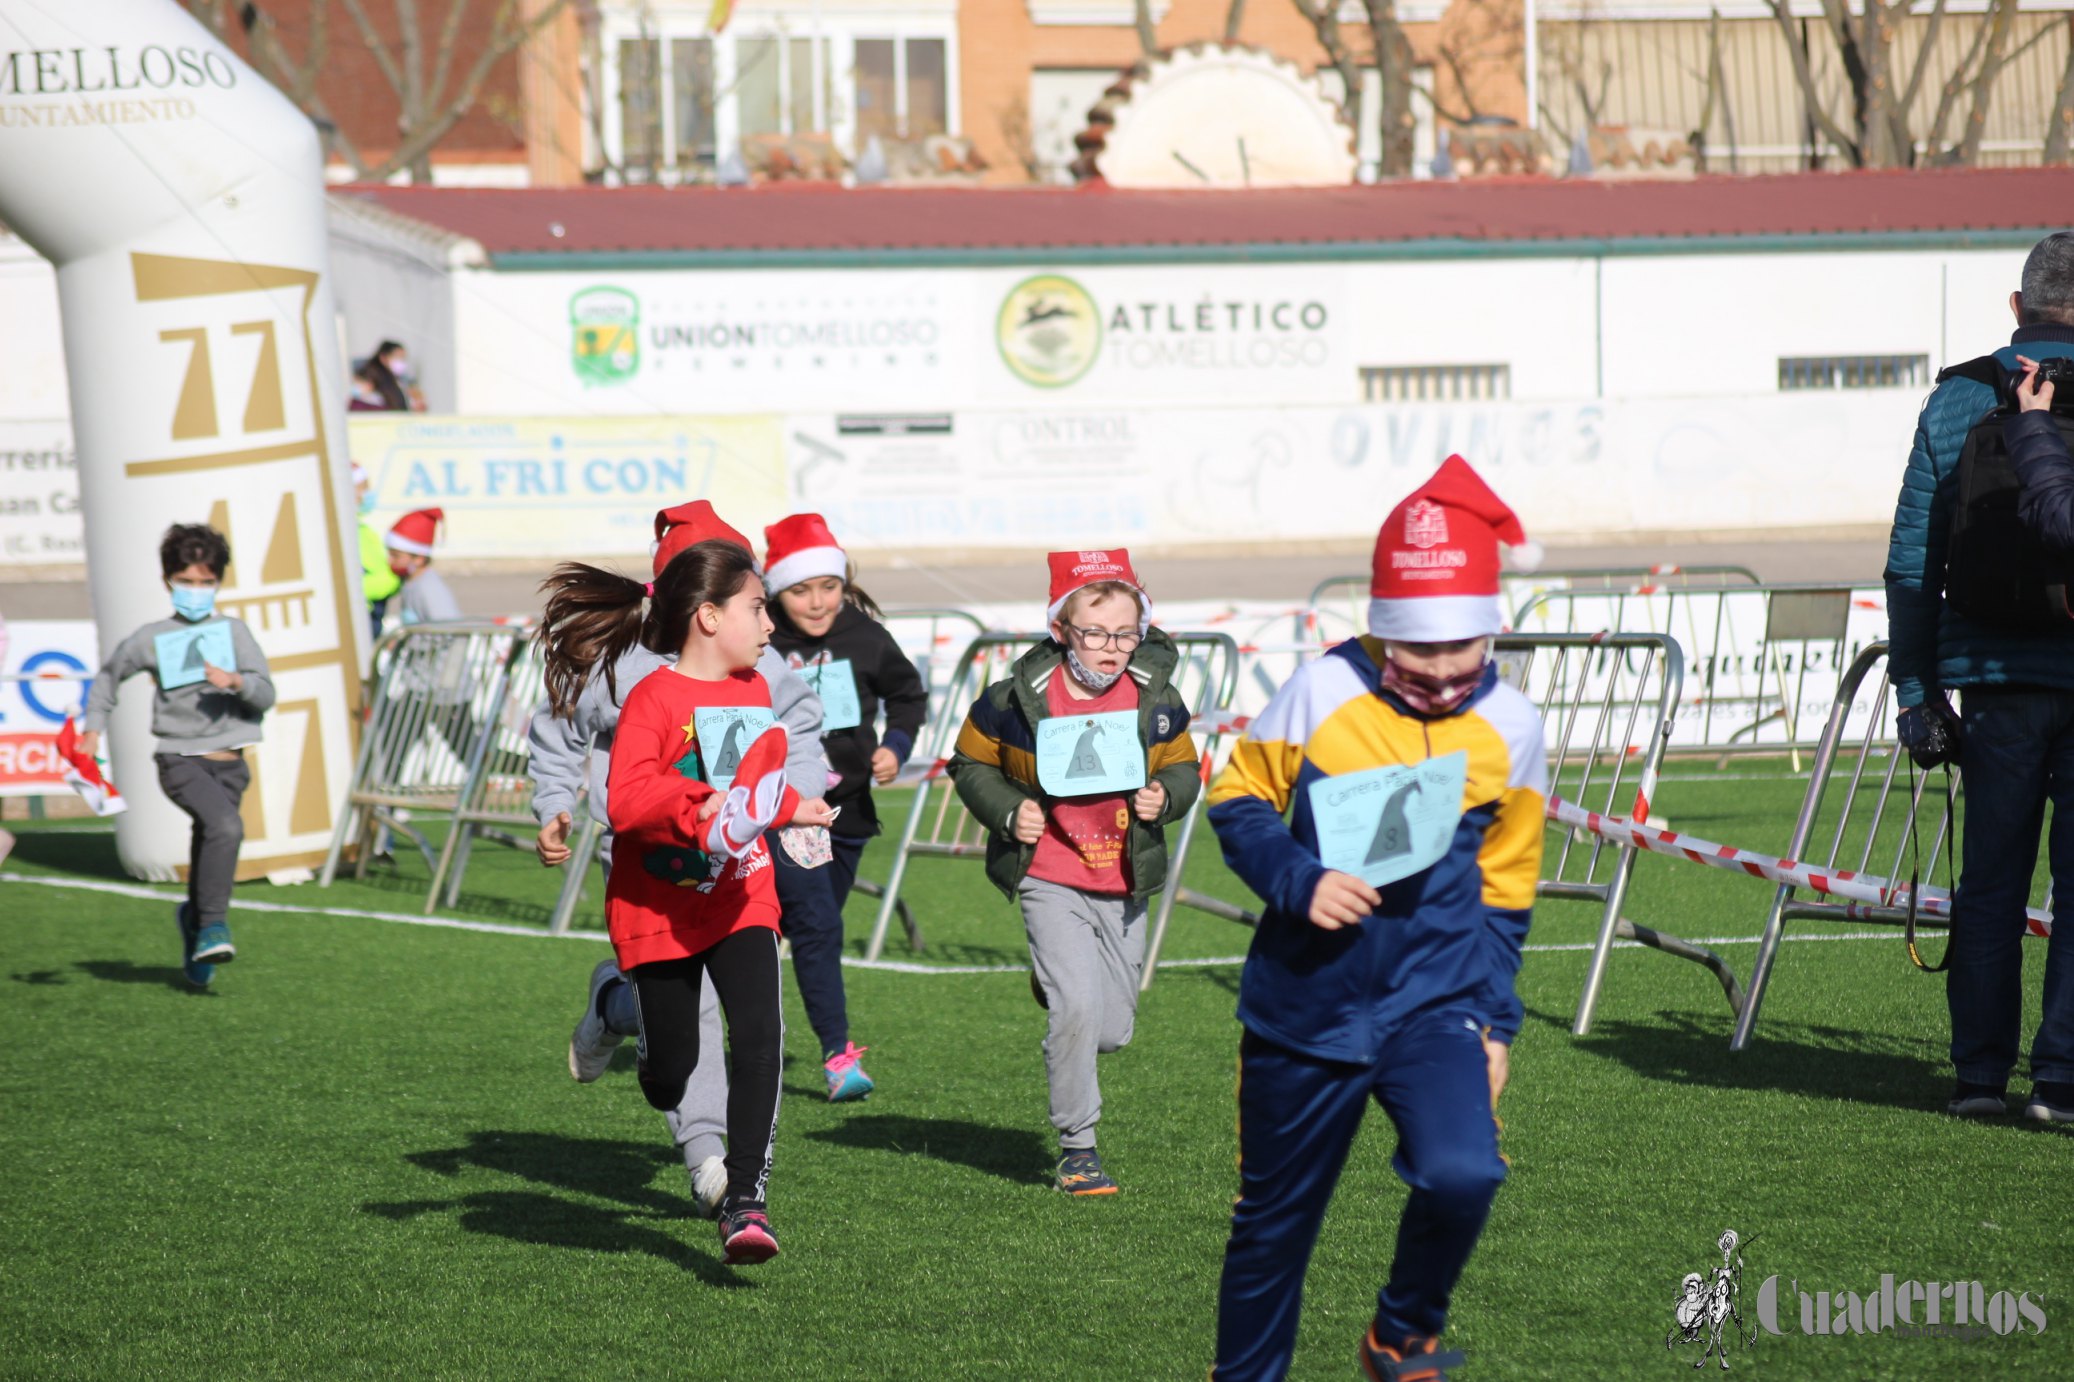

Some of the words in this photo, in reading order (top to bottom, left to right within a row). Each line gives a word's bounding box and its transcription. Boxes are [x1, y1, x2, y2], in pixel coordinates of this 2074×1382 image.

[1109, 291, 1329, 332] ATLÉTICO
[1109, 336, 1330, 370] TOMELLOSO
[1071, 563, 1124, 576] TOMELLOSO
[697, 714, 724, 730] Carrera
[745, 713, 769, 729] Noel
[1044, 722, 1077, 740] Carrera
[1104, 719, 1131, 732] Noel
[726, 751, 734, 769] 2
[1075, 754, 1097, 773] 13
[1326, 779, 1382, 808] Carrera
[1423, 769, 1454, 786] Noel
